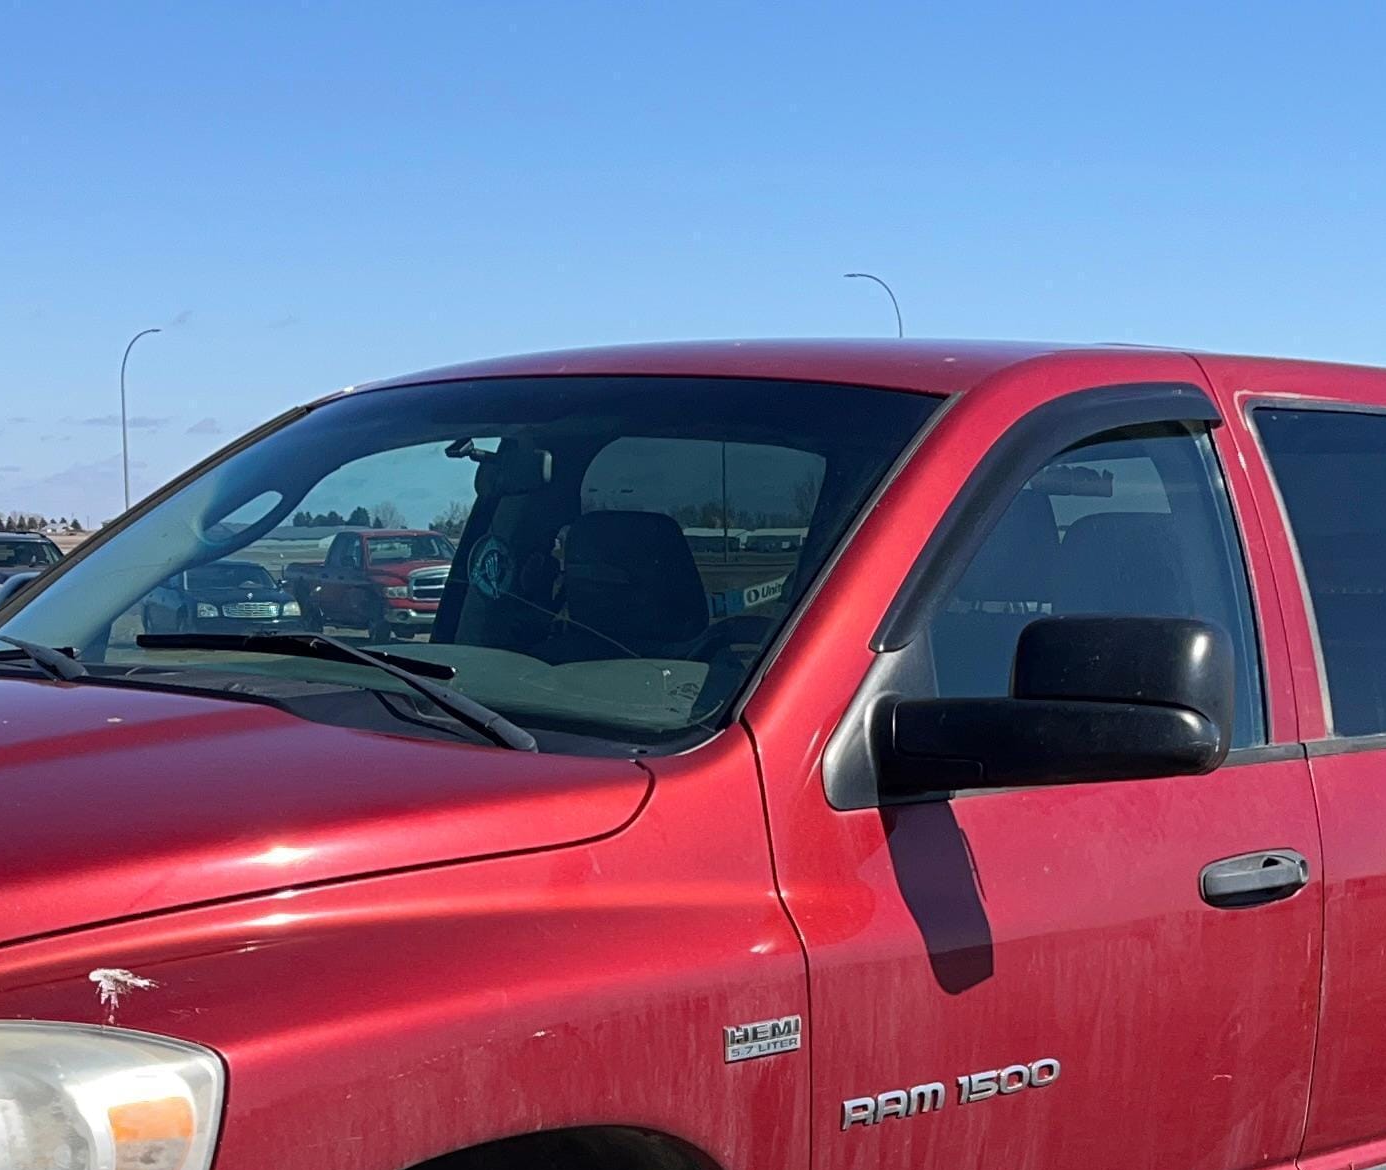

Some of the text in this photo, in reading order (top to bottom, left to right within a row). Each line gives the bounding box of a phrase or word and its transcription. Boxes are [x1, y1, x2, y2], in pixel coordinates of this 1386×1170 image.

[725, 1016, 801, 1046] HEMI
[731, 1037, 798, 1058] 5.7 LITER
[842, 1057, 1062, 1131] RAM 1500
